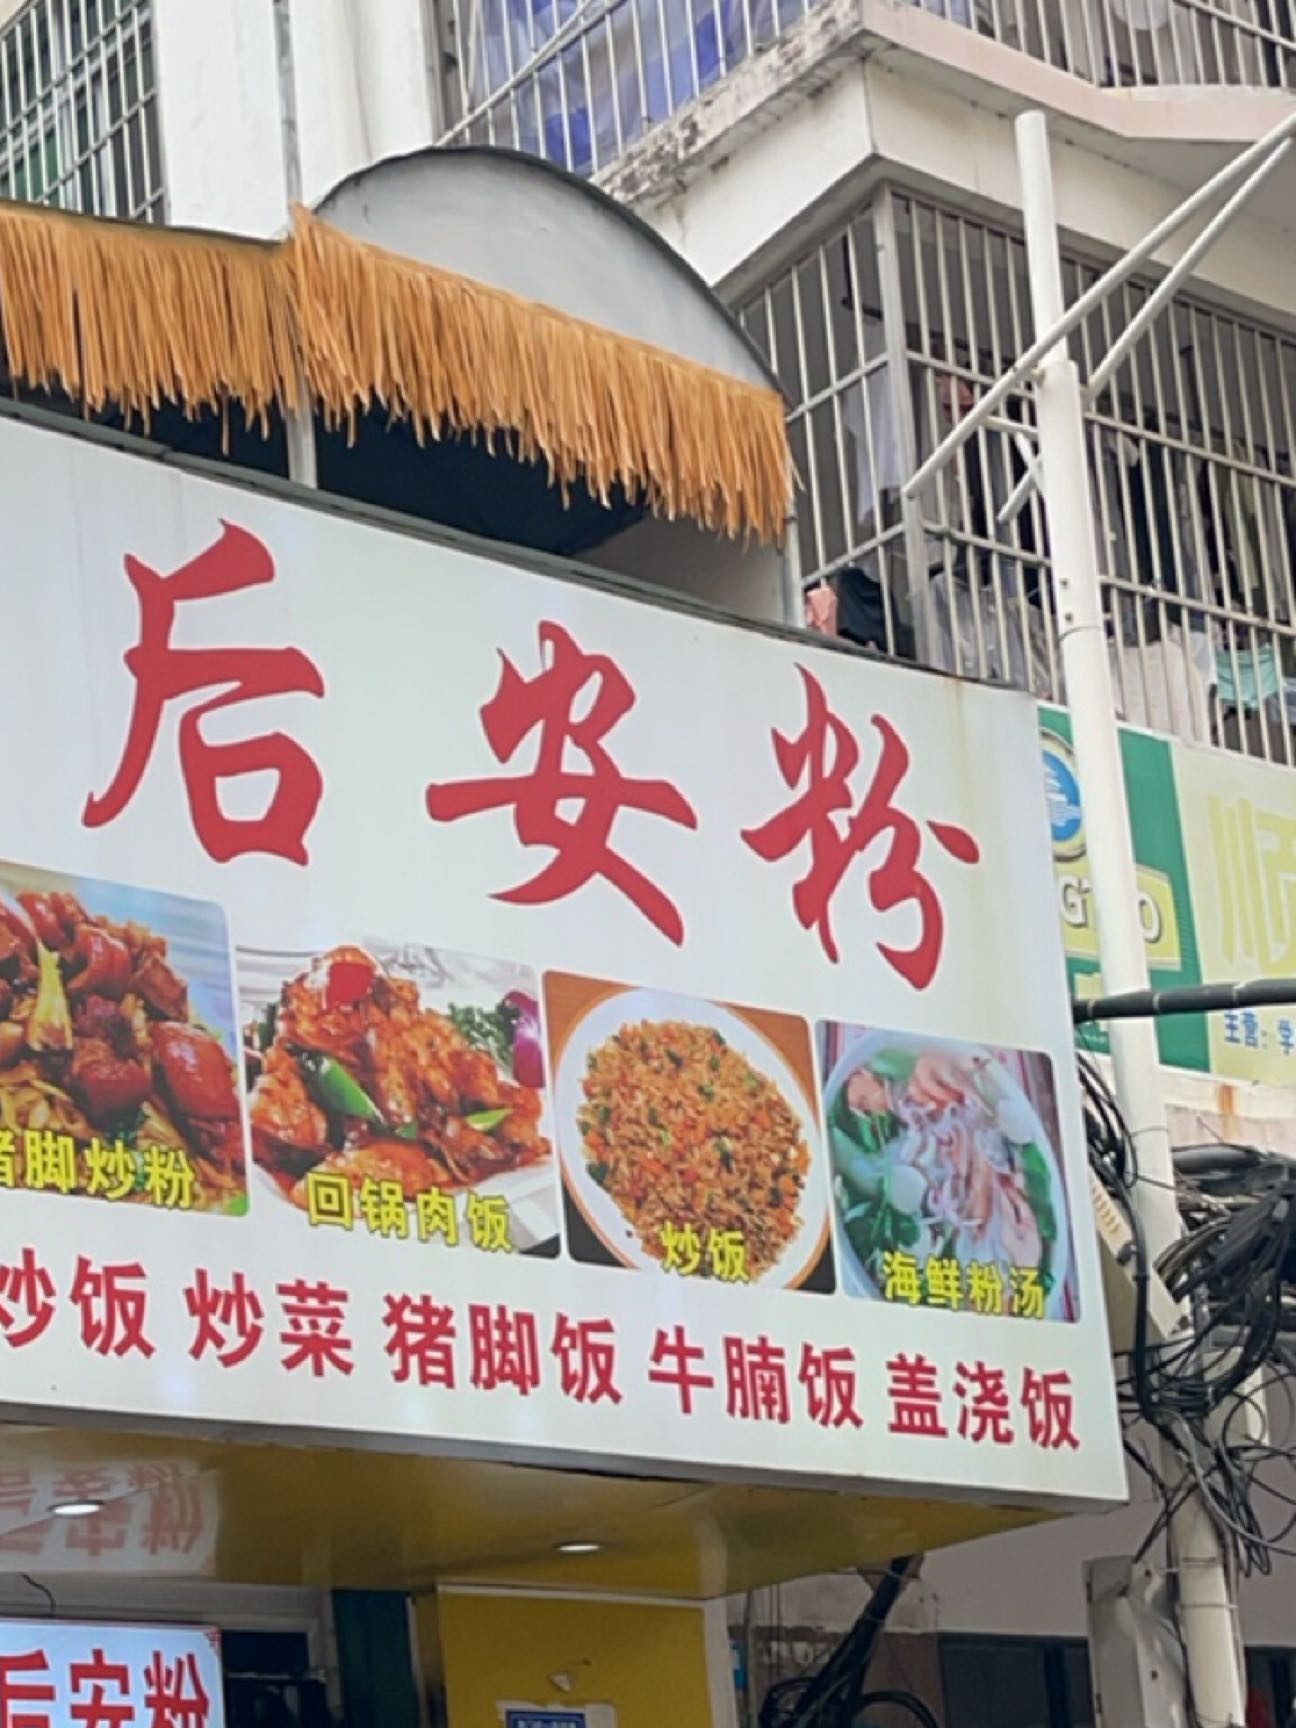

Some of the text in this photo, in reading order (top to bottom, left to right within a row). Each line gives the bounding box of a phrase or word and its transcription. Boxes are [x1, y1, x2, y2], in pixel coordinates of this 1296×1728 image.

[306, 1171, 513, 1255] 回锅肉饭
[660, 1221, 752, 1284] 炒饭
[881, 1248, 1048, 1321] 海鲜粉汤
[185, 1267, 357, 1379] 炒菜
[381, 1290, 624, 1405] 猪脚饭
[647, 1324, 865, 1432] 牛腩饭
[885, 1351, 1082, 1452] 盖浇饭
